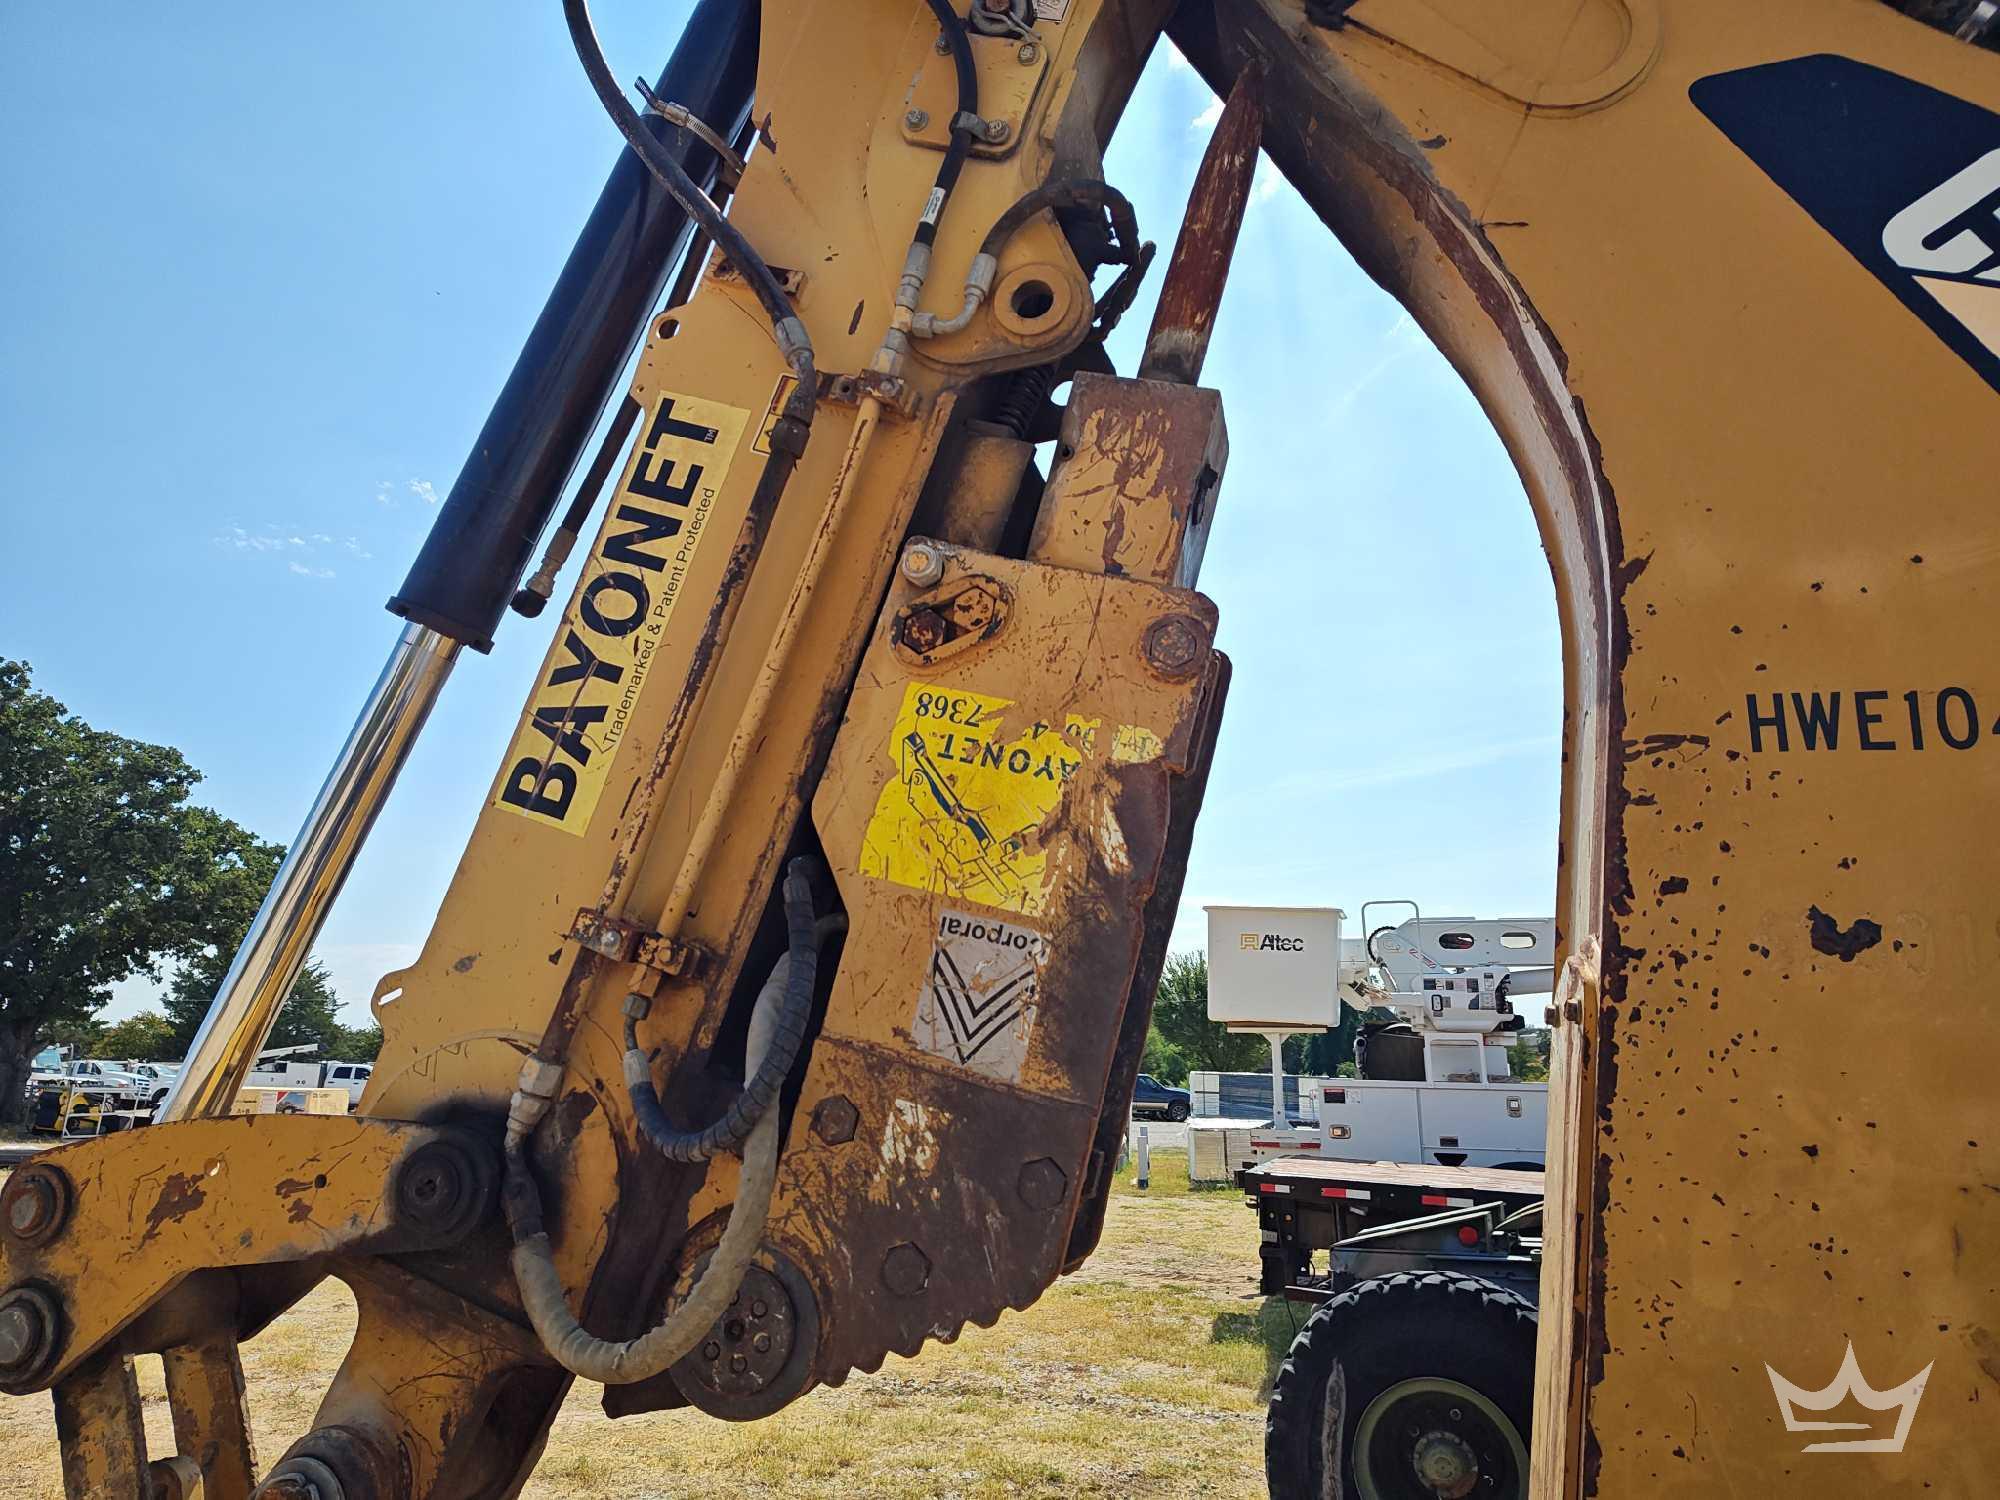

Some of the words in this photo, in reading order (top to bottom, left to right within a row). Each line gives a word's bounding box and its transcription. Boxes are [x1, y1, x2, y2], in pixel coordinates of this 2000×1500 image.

[680, 487, 715, 563] Protected
[501, 397, 718, 820] BAYONET
[653, 572, 685, 619] Patent
[647, 623, 661, 635] &
[603, 638, 655, 745] Trademarked
[915, 692, 983, 728] 7368
[938, 732, 1081, 781] AYONET
[1259, 933, 1304, 952] Altec
